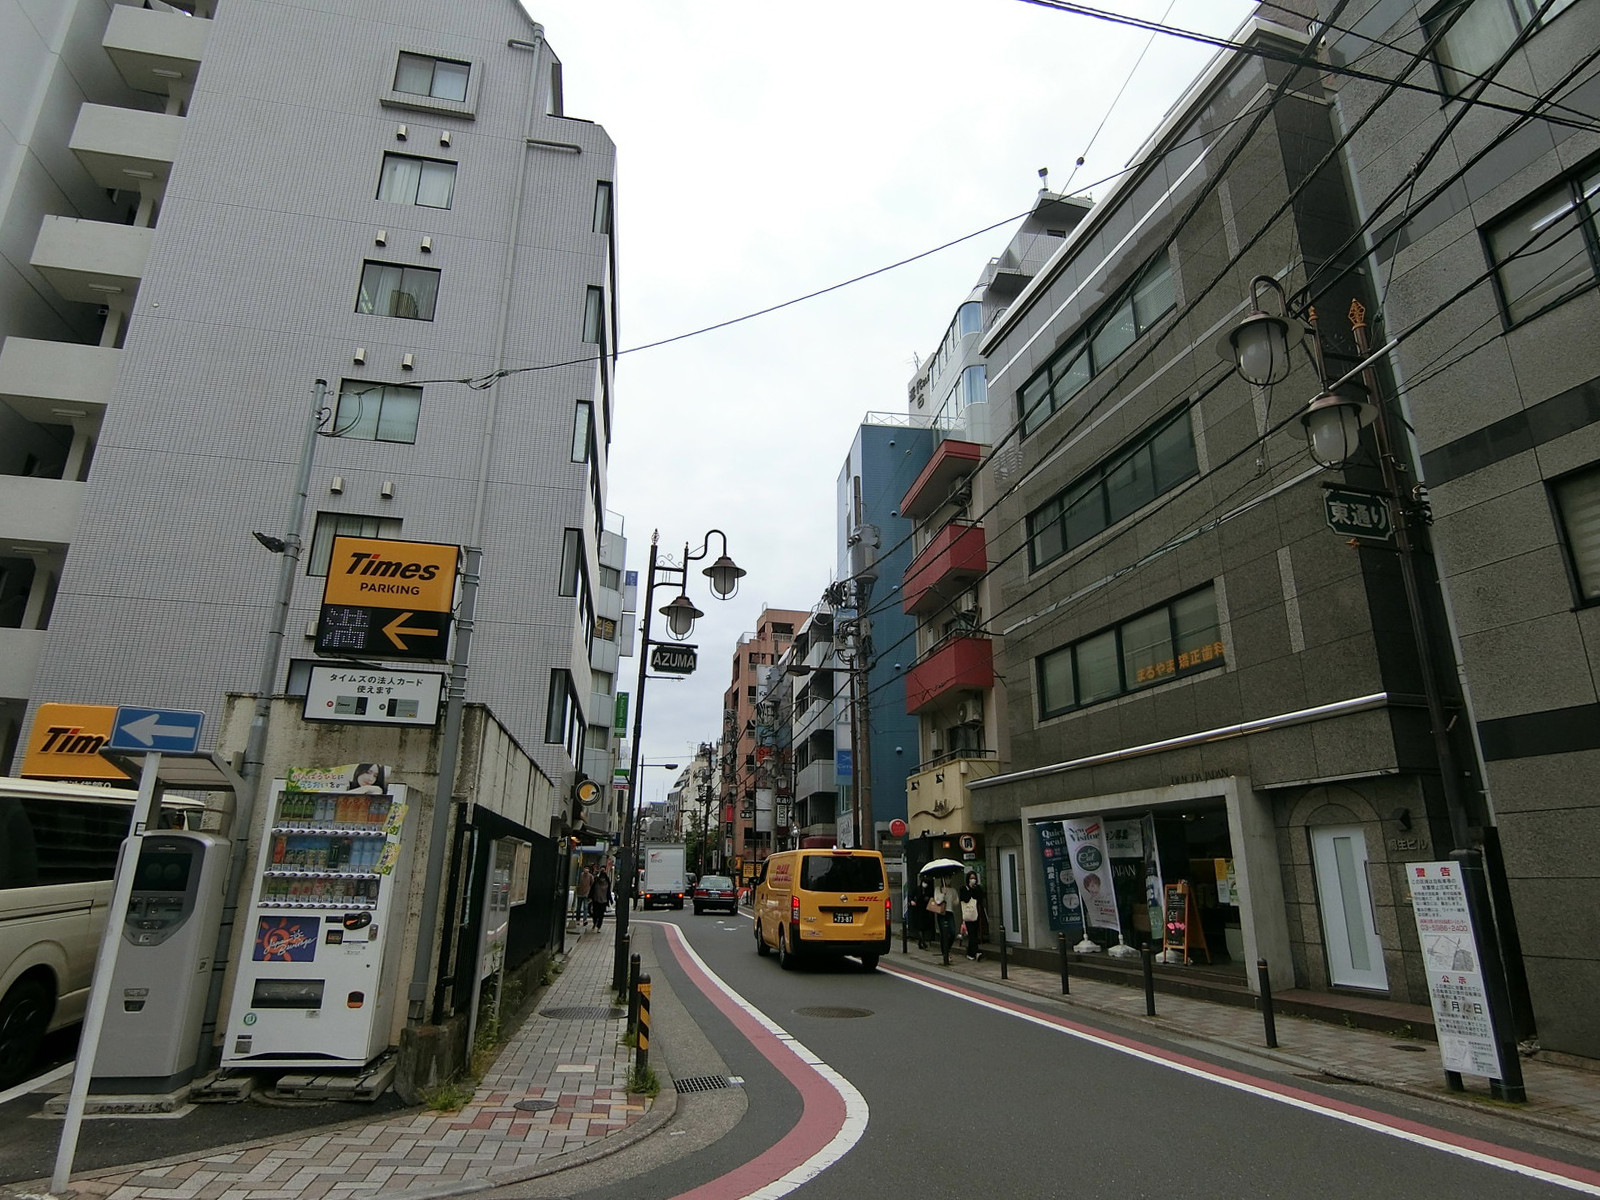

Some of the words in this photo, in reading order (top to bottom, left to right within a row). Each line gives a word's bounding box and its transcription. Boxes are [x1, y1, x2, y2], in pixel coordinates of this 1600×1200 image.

[1328, 501, 1387, 530] 東通り
[345, 552, 440, 581] Times
[359, 582, 421, 596] PARKING
[652, 651, 695, 669] AZUMA
[329, 672, 424, 688] タイムズの法人カード
[356, 685, 394, 695] 使えます
[40, 727, 109, 754] Tim
